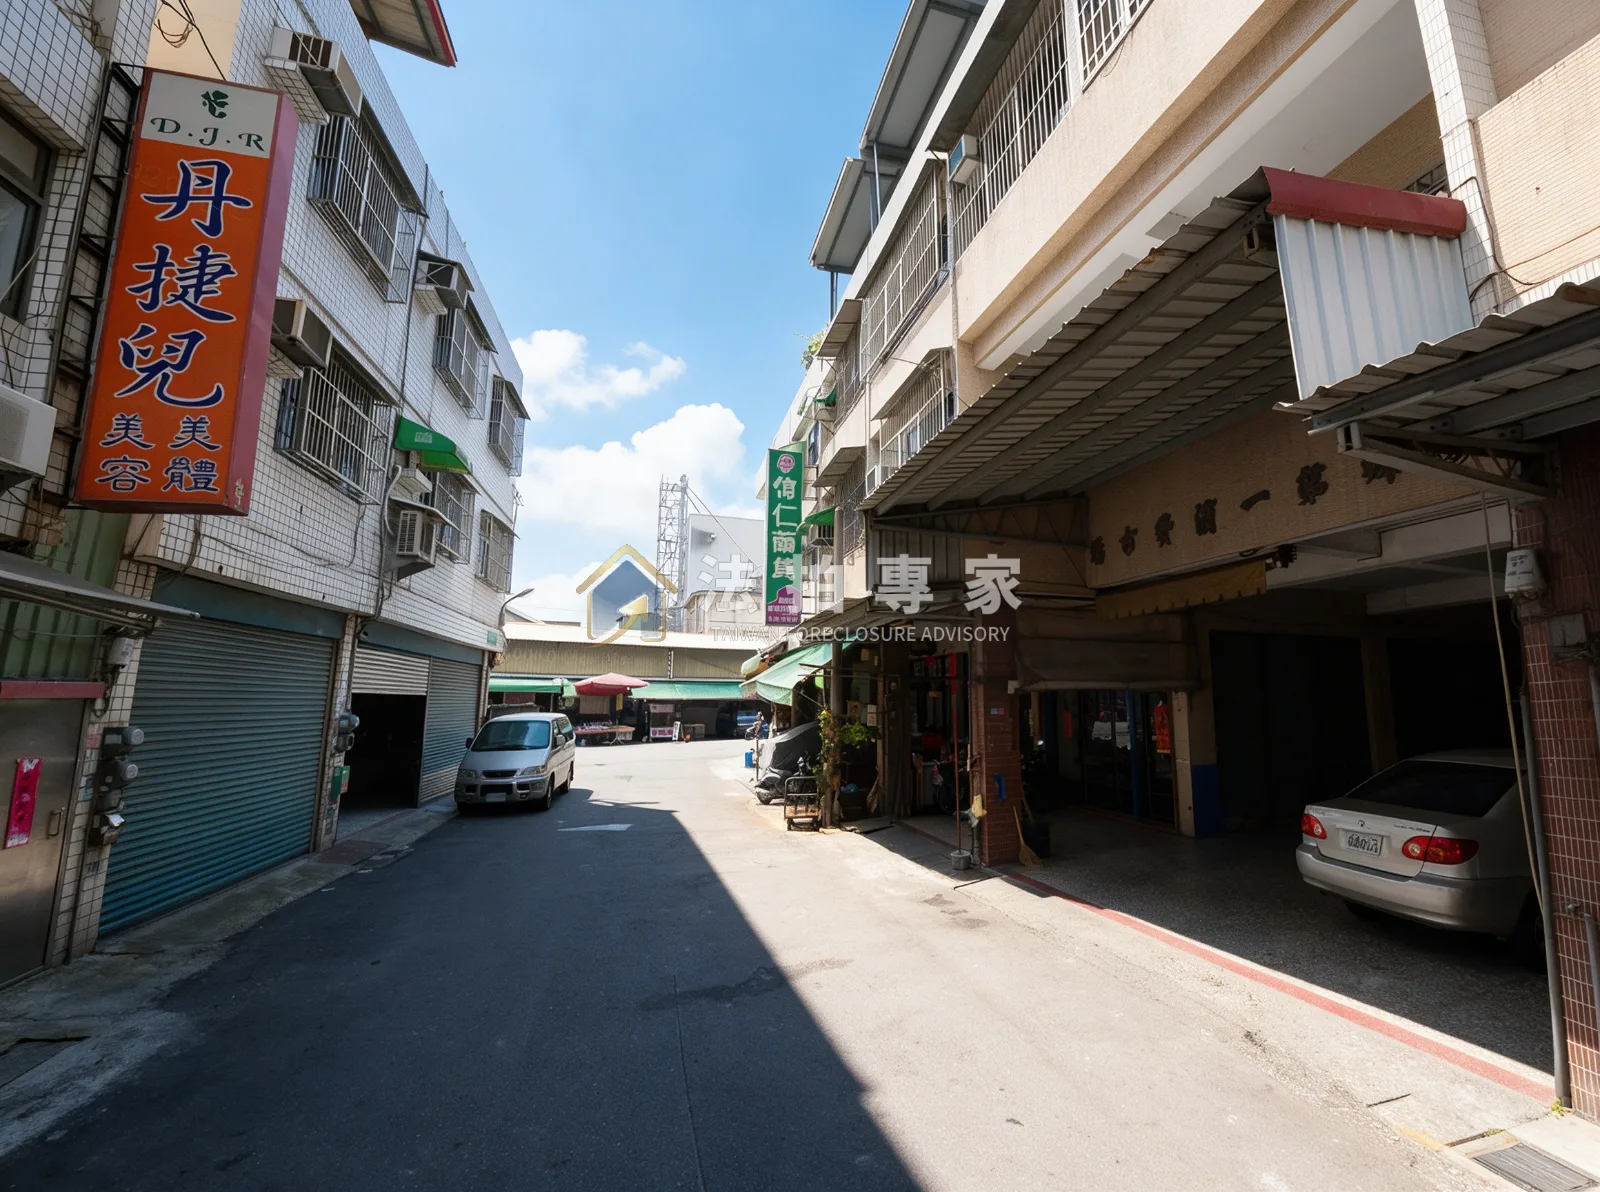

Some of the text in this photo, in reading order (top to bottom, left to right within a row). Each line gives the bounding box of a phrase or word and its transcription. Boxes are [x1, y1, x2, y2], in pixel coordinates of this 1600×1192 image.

[113, 158, 252, 408] 丹捷兒
[95, 412, 156, 493] 美容
[162, 414, 223, 495] 美體
